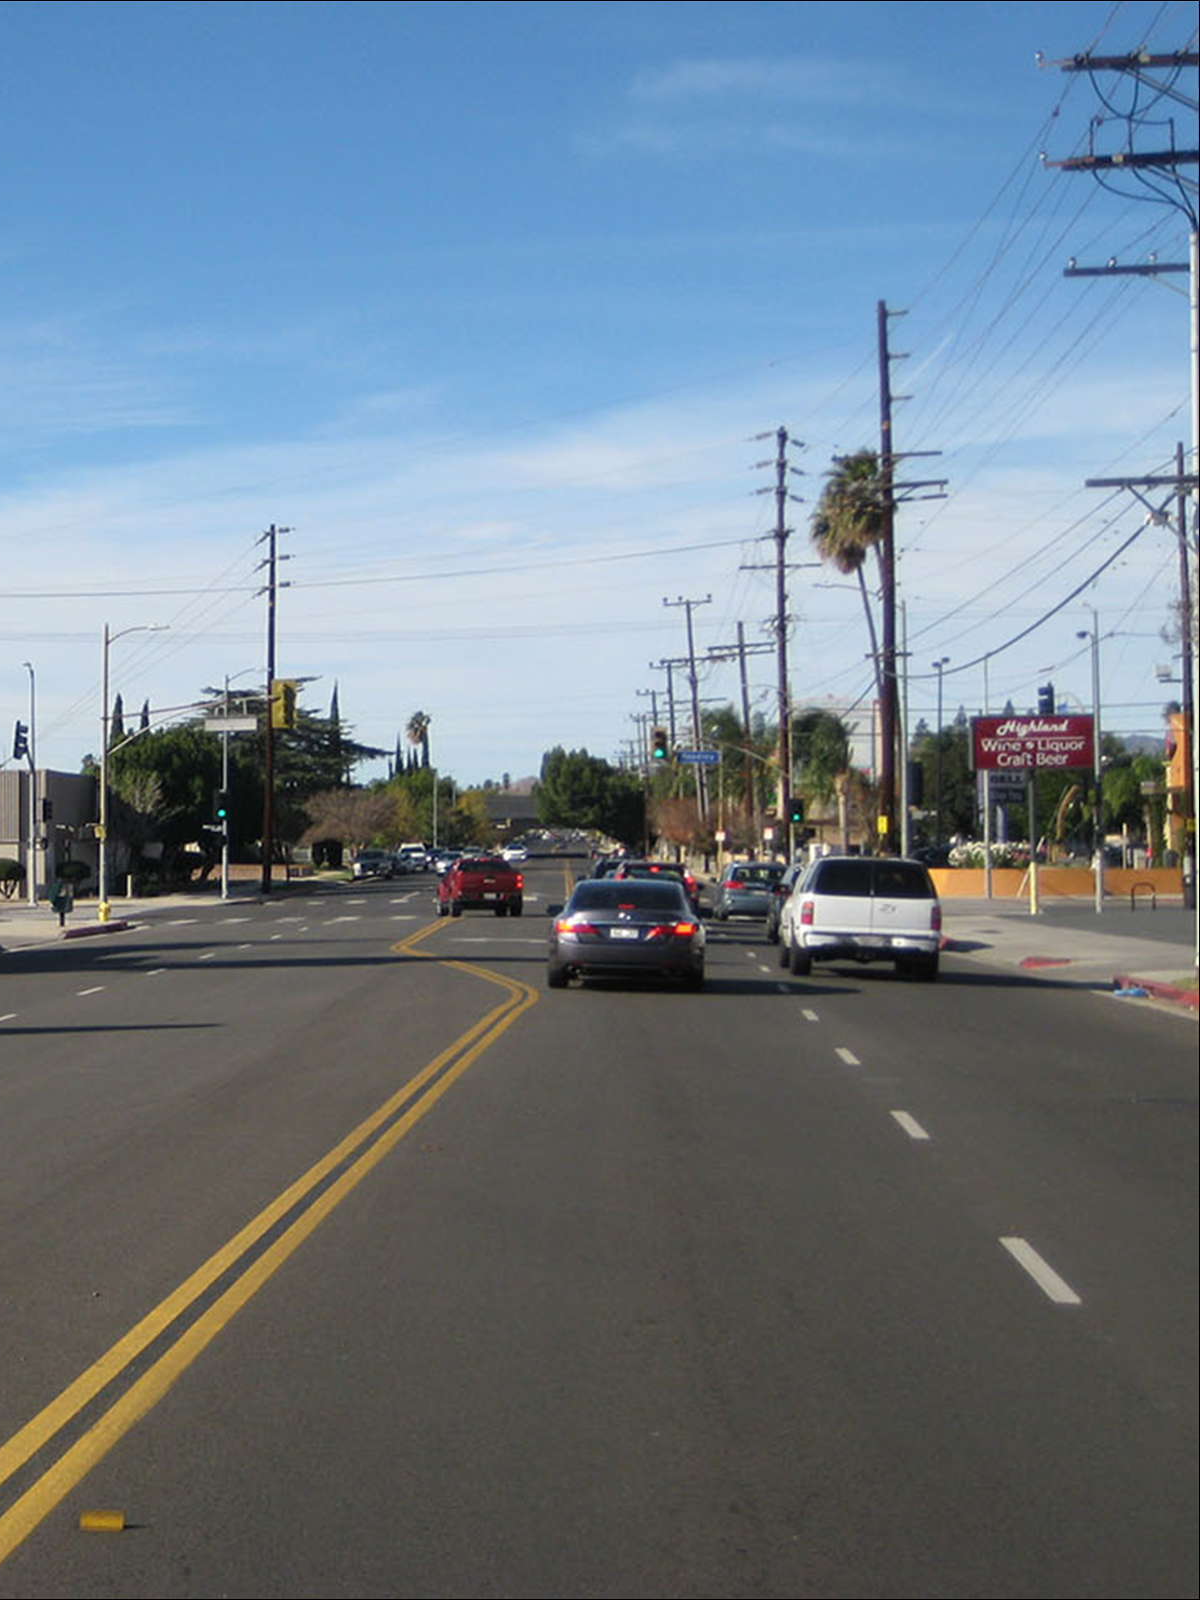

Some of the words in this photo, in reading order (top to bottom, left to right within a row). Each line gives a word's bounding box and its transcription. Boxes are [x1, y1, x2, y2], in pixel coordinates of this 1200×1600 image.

[996, 719, 1069, 737] Highland
[981, 739, 1021, 752] Wine
[1038, 739, 1086, 752] Liquor
[997, 752, 1033, 766] Craft
[1036, 753, 1068, 766] Beer
